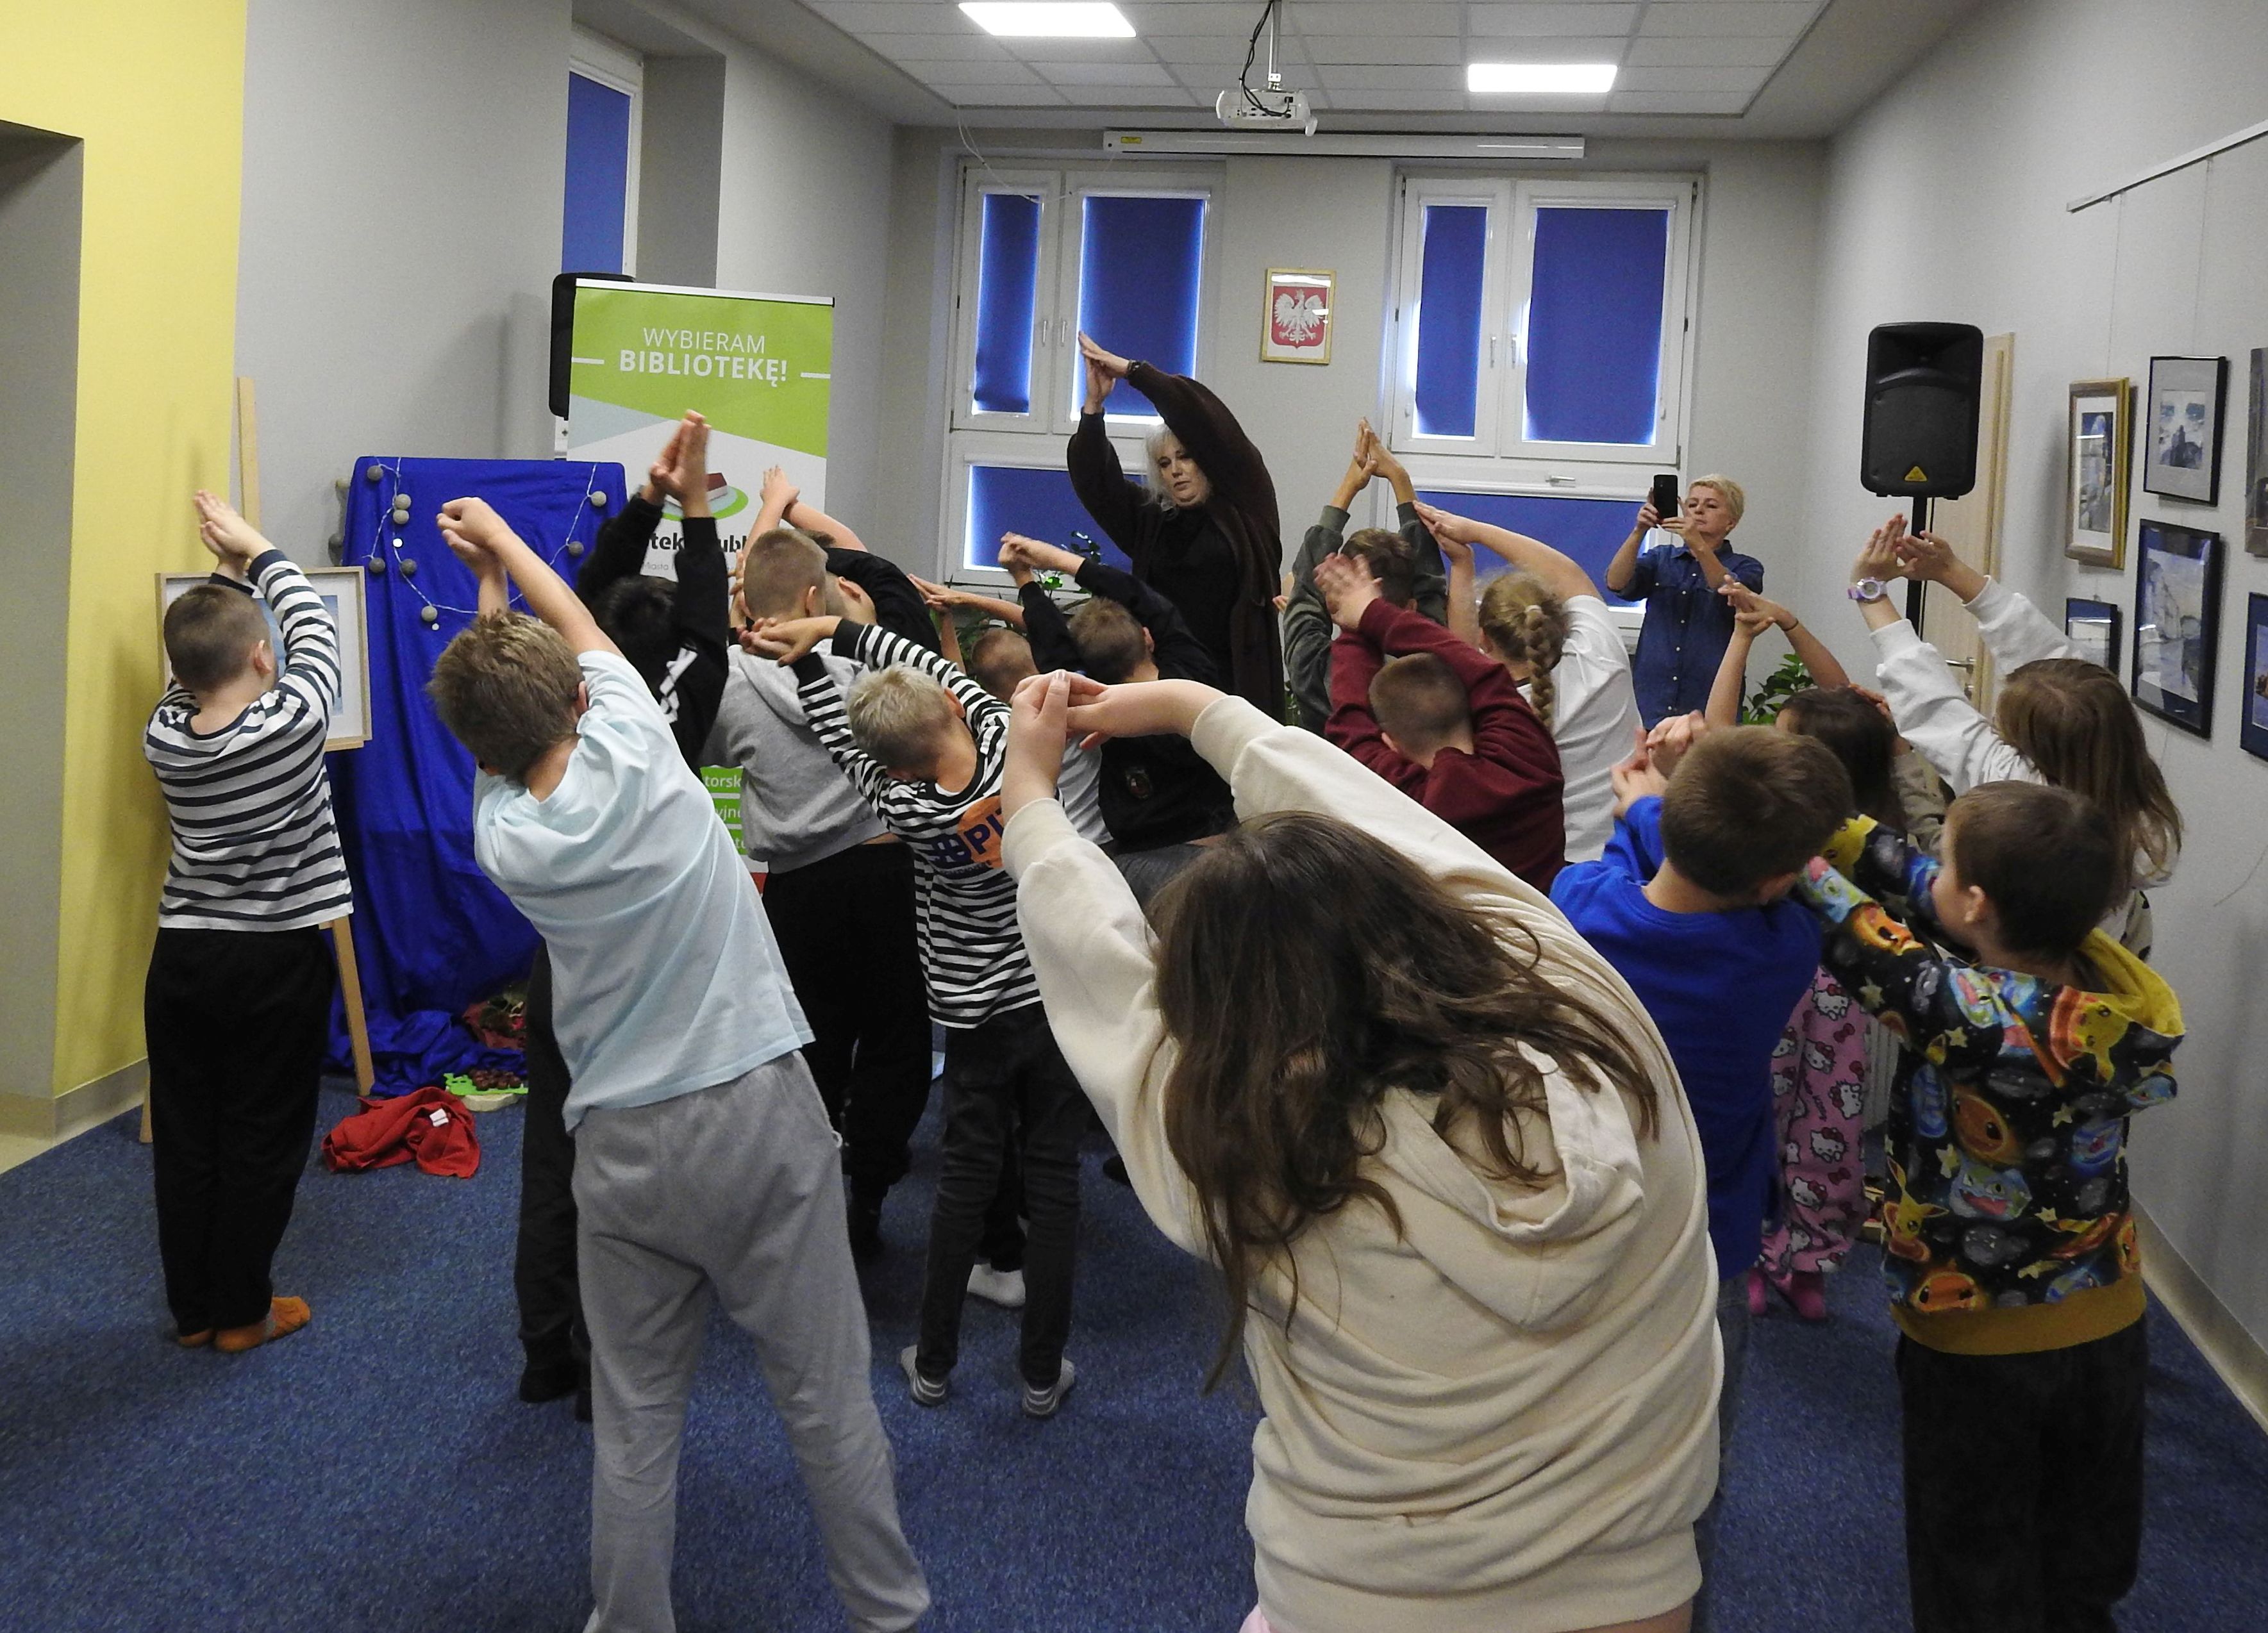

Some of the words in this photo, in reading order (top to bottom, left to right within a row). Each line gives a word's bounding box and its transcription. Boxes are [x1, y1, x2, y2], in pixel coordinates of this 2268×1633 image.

[644, 327, 765, 354] WYBIERAM
[620, 350, 787, 387] BIBLIOTEKĘ!
[650, 533, 685, 550] tek
[705, 775, 741, 788] torsk
